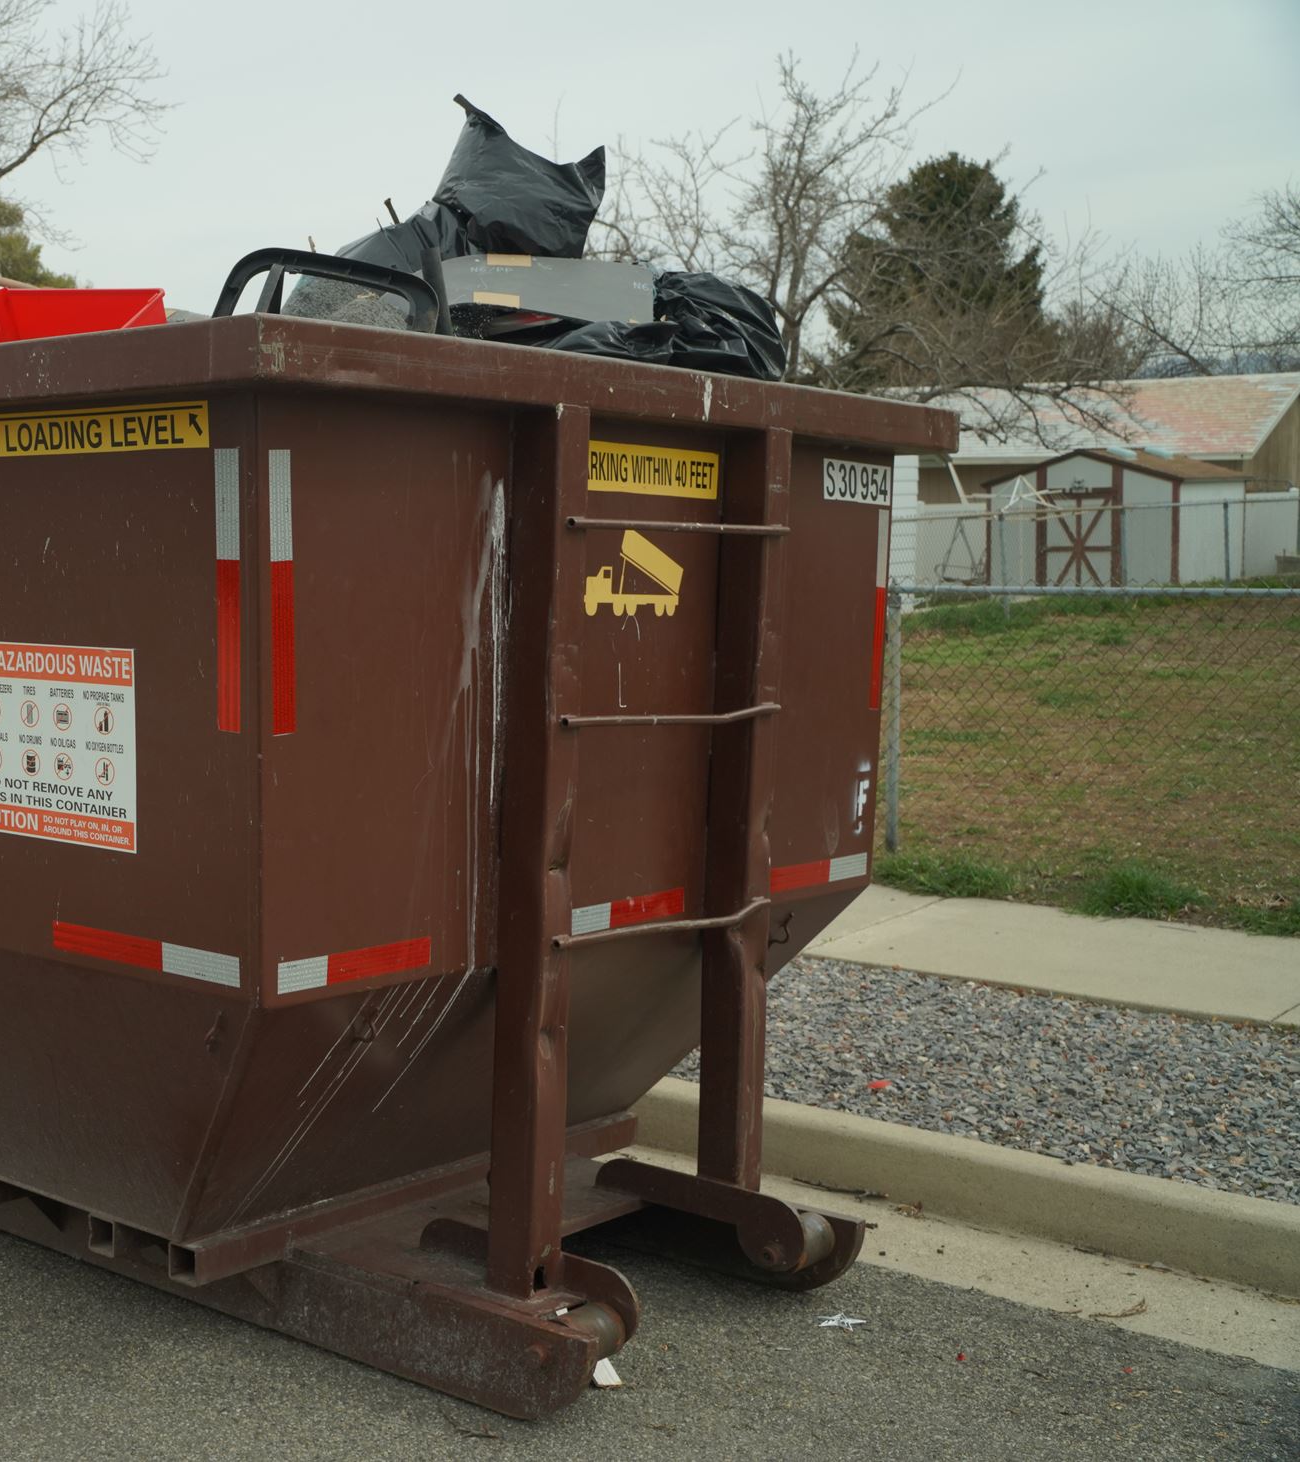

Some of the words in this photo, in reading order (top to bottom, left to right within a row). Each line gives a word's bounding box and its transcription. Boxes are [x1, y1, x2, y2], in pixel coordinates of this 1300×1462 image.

[4, 419, 102, 452] LOADING
[110, 414, 184, 447] LEVEL
[588, 451, 628, 483] RKING
[631, 455, 672, 486] WITHIN
[675, 460, 687, 487] 40
[690, 460, 715, 490] FEET
[79, 655, 131, 680] WASTE
[23, 685, 36, 696] TIRES
[49, 687, 74, 699] BATTERIES
[82, 690, 89, 700] NO
[90, 691, 110, 702] PROPANE
[110, 692, 124, 703] TANKS
[19, 734, 25, 744] NO
[26, 735, 42, 745] DRUMS
[50, 737, 57, 747] NO
[58, 738, 76, 749] OIL/GAS
[85, 741, 91, 751] NO
[4, 778, 29, 790] NOT
[33, 781, 84, 798] REMOVE
[87, 788, 113, 801] ANY
[11, 793, 22, 804] IN
[26, 795, 52, 808] THIS
[56, 799, 127, 819] CONTAINER
[43, 815, 53, 823] DO
[54, 816, 68, 825] NOT
[70, 818, 87, 828] PLAY
[87, 821, 100, 831] ON,
[112, 825, 122, 834] OR
[43, 825, 72, 836] AROUND
[73, 829, 88, 839] THIS
[90, 832, 131, 846] CONTAINER.
